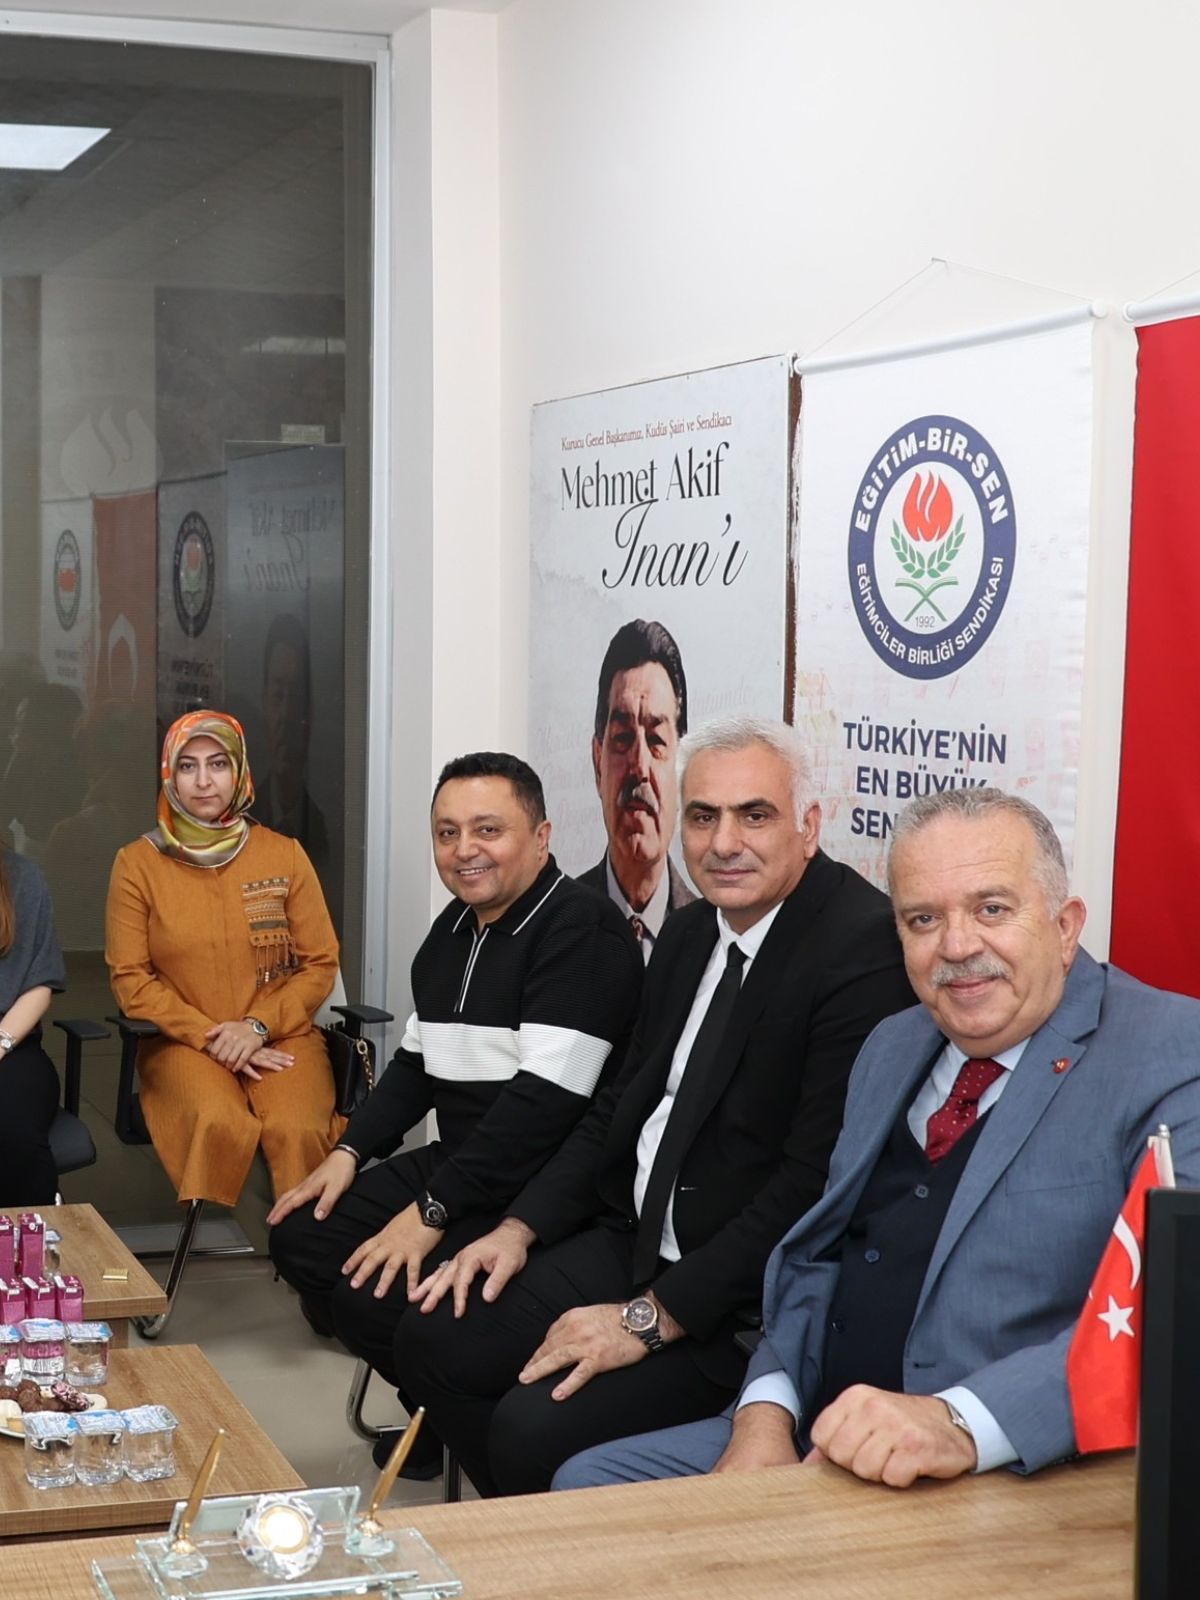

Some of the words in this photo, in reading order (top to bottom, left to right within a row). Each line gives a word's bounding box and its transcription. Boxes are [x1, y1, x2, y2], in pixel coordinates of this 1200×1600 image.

[561, 437, 585, 451] Kurucu
[585, 430, 604, 448] Genel
[645, 422, 668, 439] Kudüs
[669, 418, 686, 439] Şairi
[686, 420, 695, 432] ve
[696, 412, 732, 431] Sendikacı
[561, 458, 658, 511] Mehmet
[666, 441, 730, 501] Akif
[855, 427, 1009, 532] EĞİTİM-BİR-SEN
[856, 563, 906, 660] EĞİTİMCİLER
[907, 639, 955, 666] BİRLİĞİ
[954, 556, 1004, 651] SENDİKASI
[914, 615, 936, 629] 1992
[843, 715, 1007, 764] TÜRKİYE'NİN
[856, 765, 889, 797] EN
